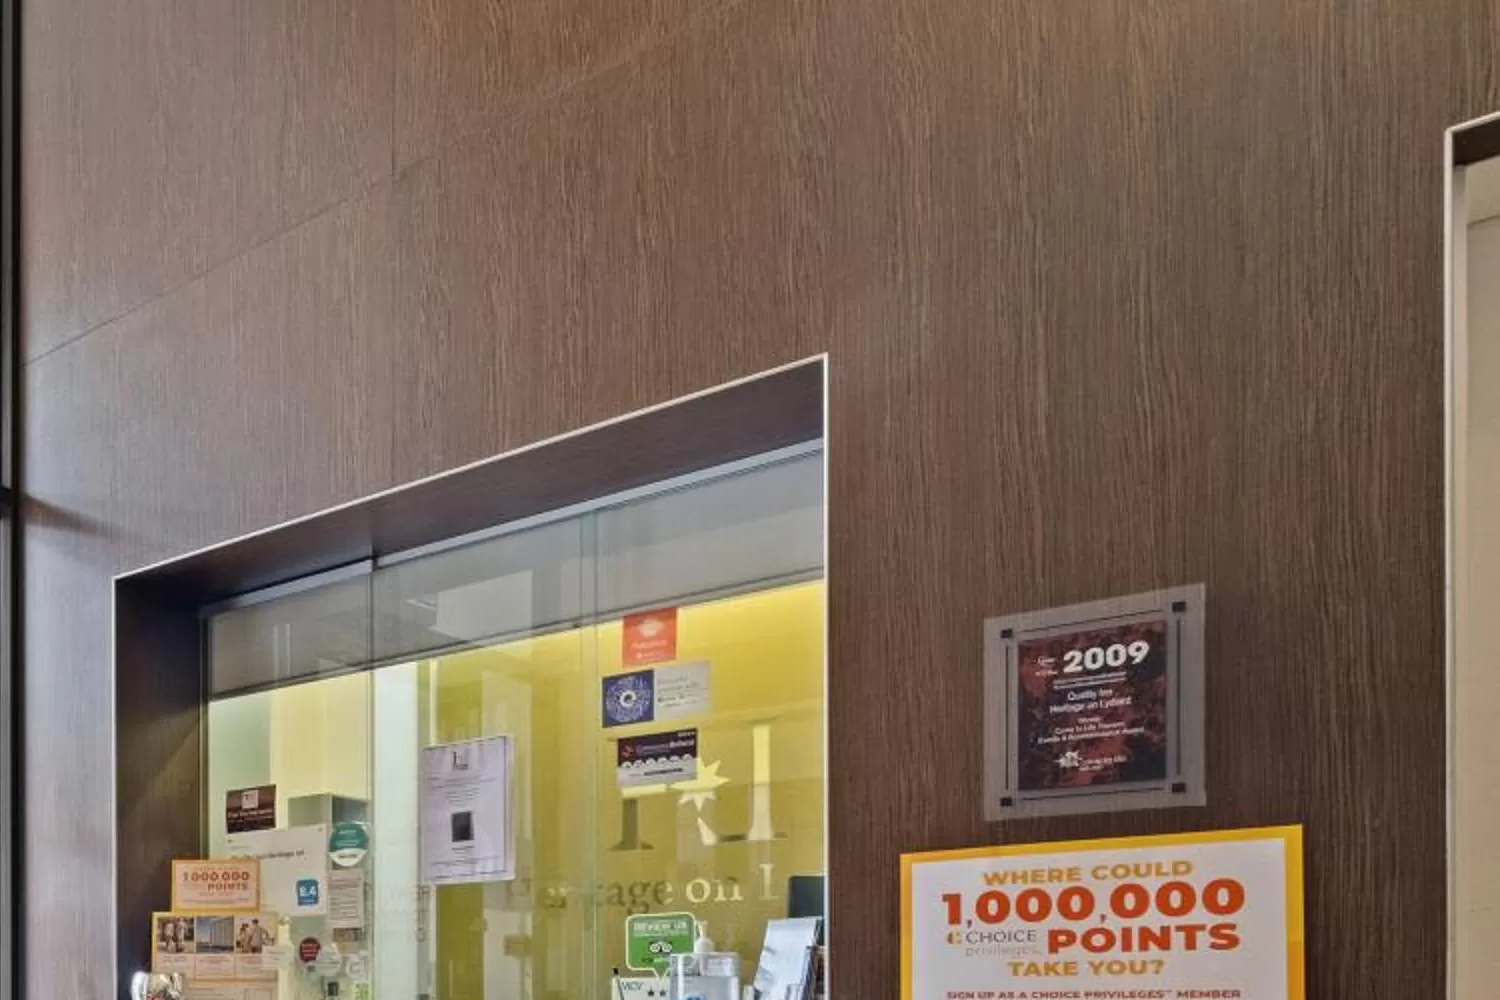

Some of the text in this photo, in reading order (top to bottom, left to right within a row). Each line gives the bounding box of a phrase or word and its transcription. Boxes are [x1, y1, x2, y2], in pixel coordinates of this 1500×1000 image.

[1063, 640, 1150, 673] 2009
[984, 860, 1192, 886] WHERE COULD
[941, 878, 1245, 928] 1,000,000
[966, 923, 1241, 955] CHOICE POINTS
[1008, 959, 1164, 977] TAKE YOU?
[978, 991, 995, 999] UP
[1031, 990, 1081, 999] CHOICE
[1177, 989, 1241, 999] MEMBER
